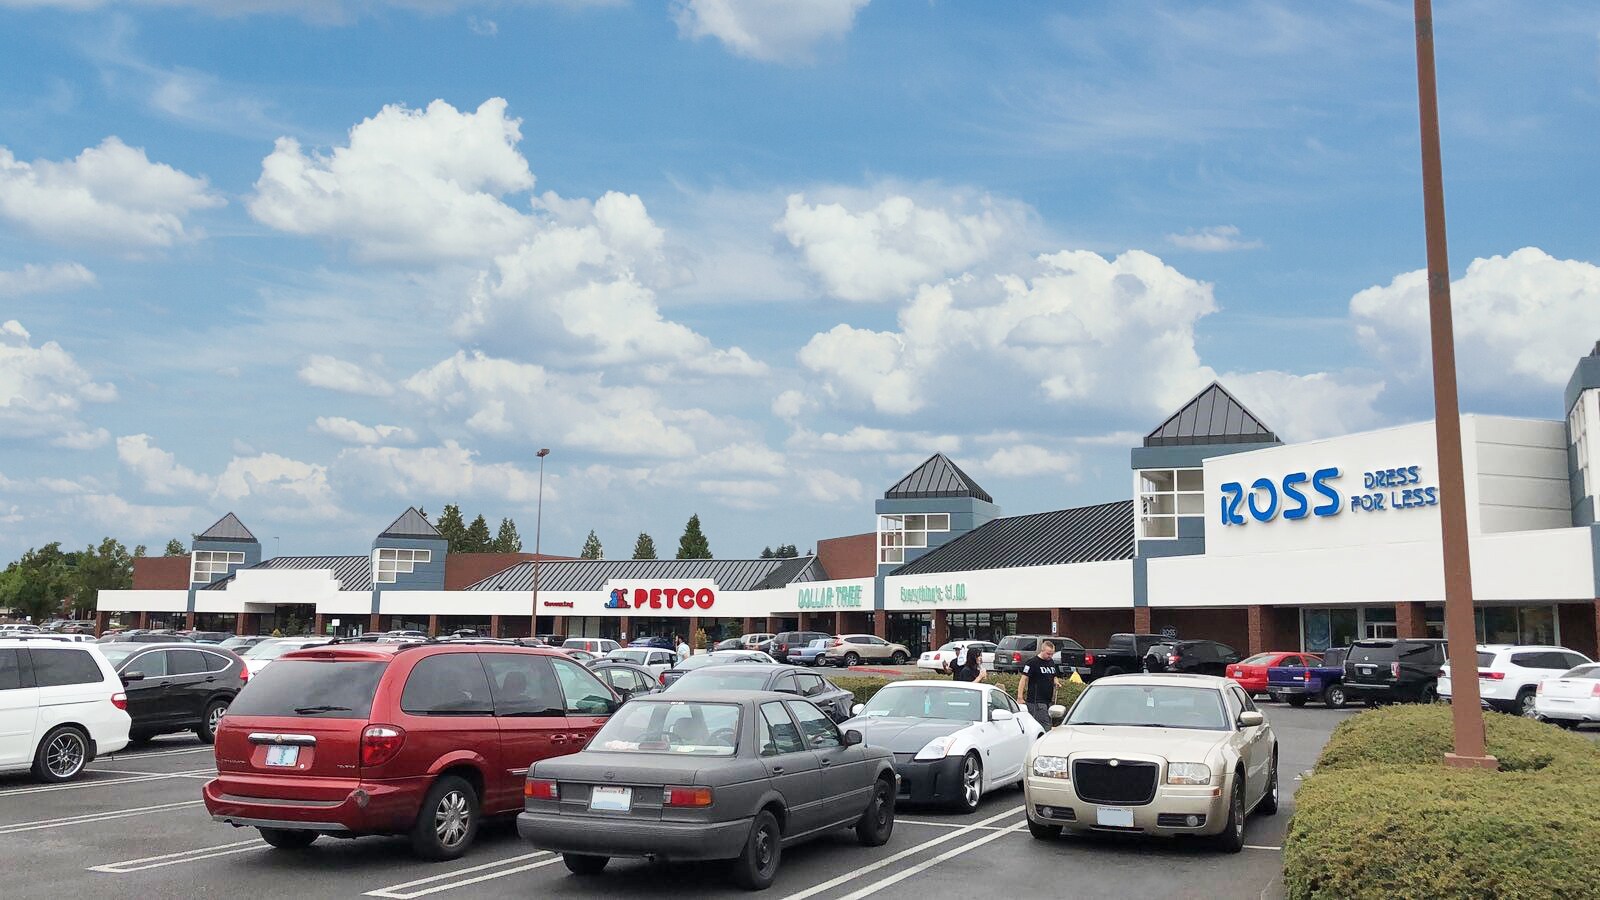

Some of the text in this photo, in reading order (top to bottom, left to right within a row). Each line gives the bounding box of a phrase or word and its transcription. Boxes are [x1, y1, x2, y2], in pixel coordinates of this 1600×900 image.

[1363, 465, 1420, 489] DRESS
[1220, 466, 1342, 525] ROSS
[1350, 486, 1438, 512] FOR LESS
[634, 587, 715, 609] PETCO
[798, 585, 862, 608] DOLLAR TREE
